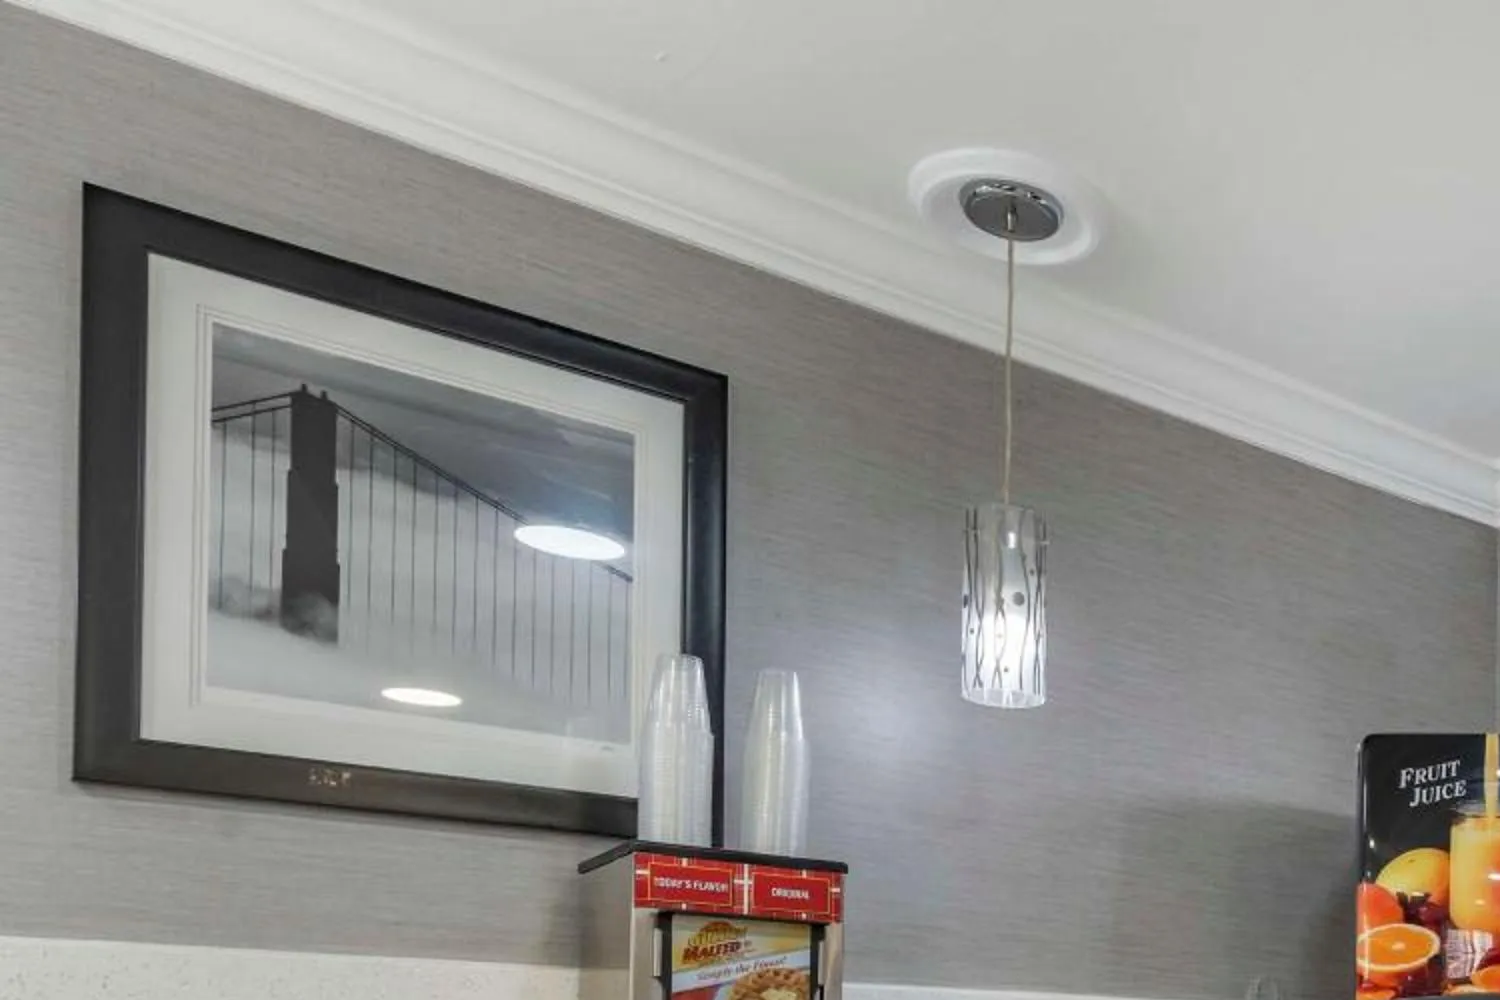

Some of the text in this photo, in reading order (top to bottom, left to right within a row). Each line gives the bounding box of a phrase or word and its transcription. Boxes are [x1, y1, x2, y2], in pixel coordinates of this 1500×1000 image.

[1398, 758, 1461, 789] FRUIT
[1408, 779, 1467, 808] JUICE
[653, 876, 692, 890] TODAY'S
